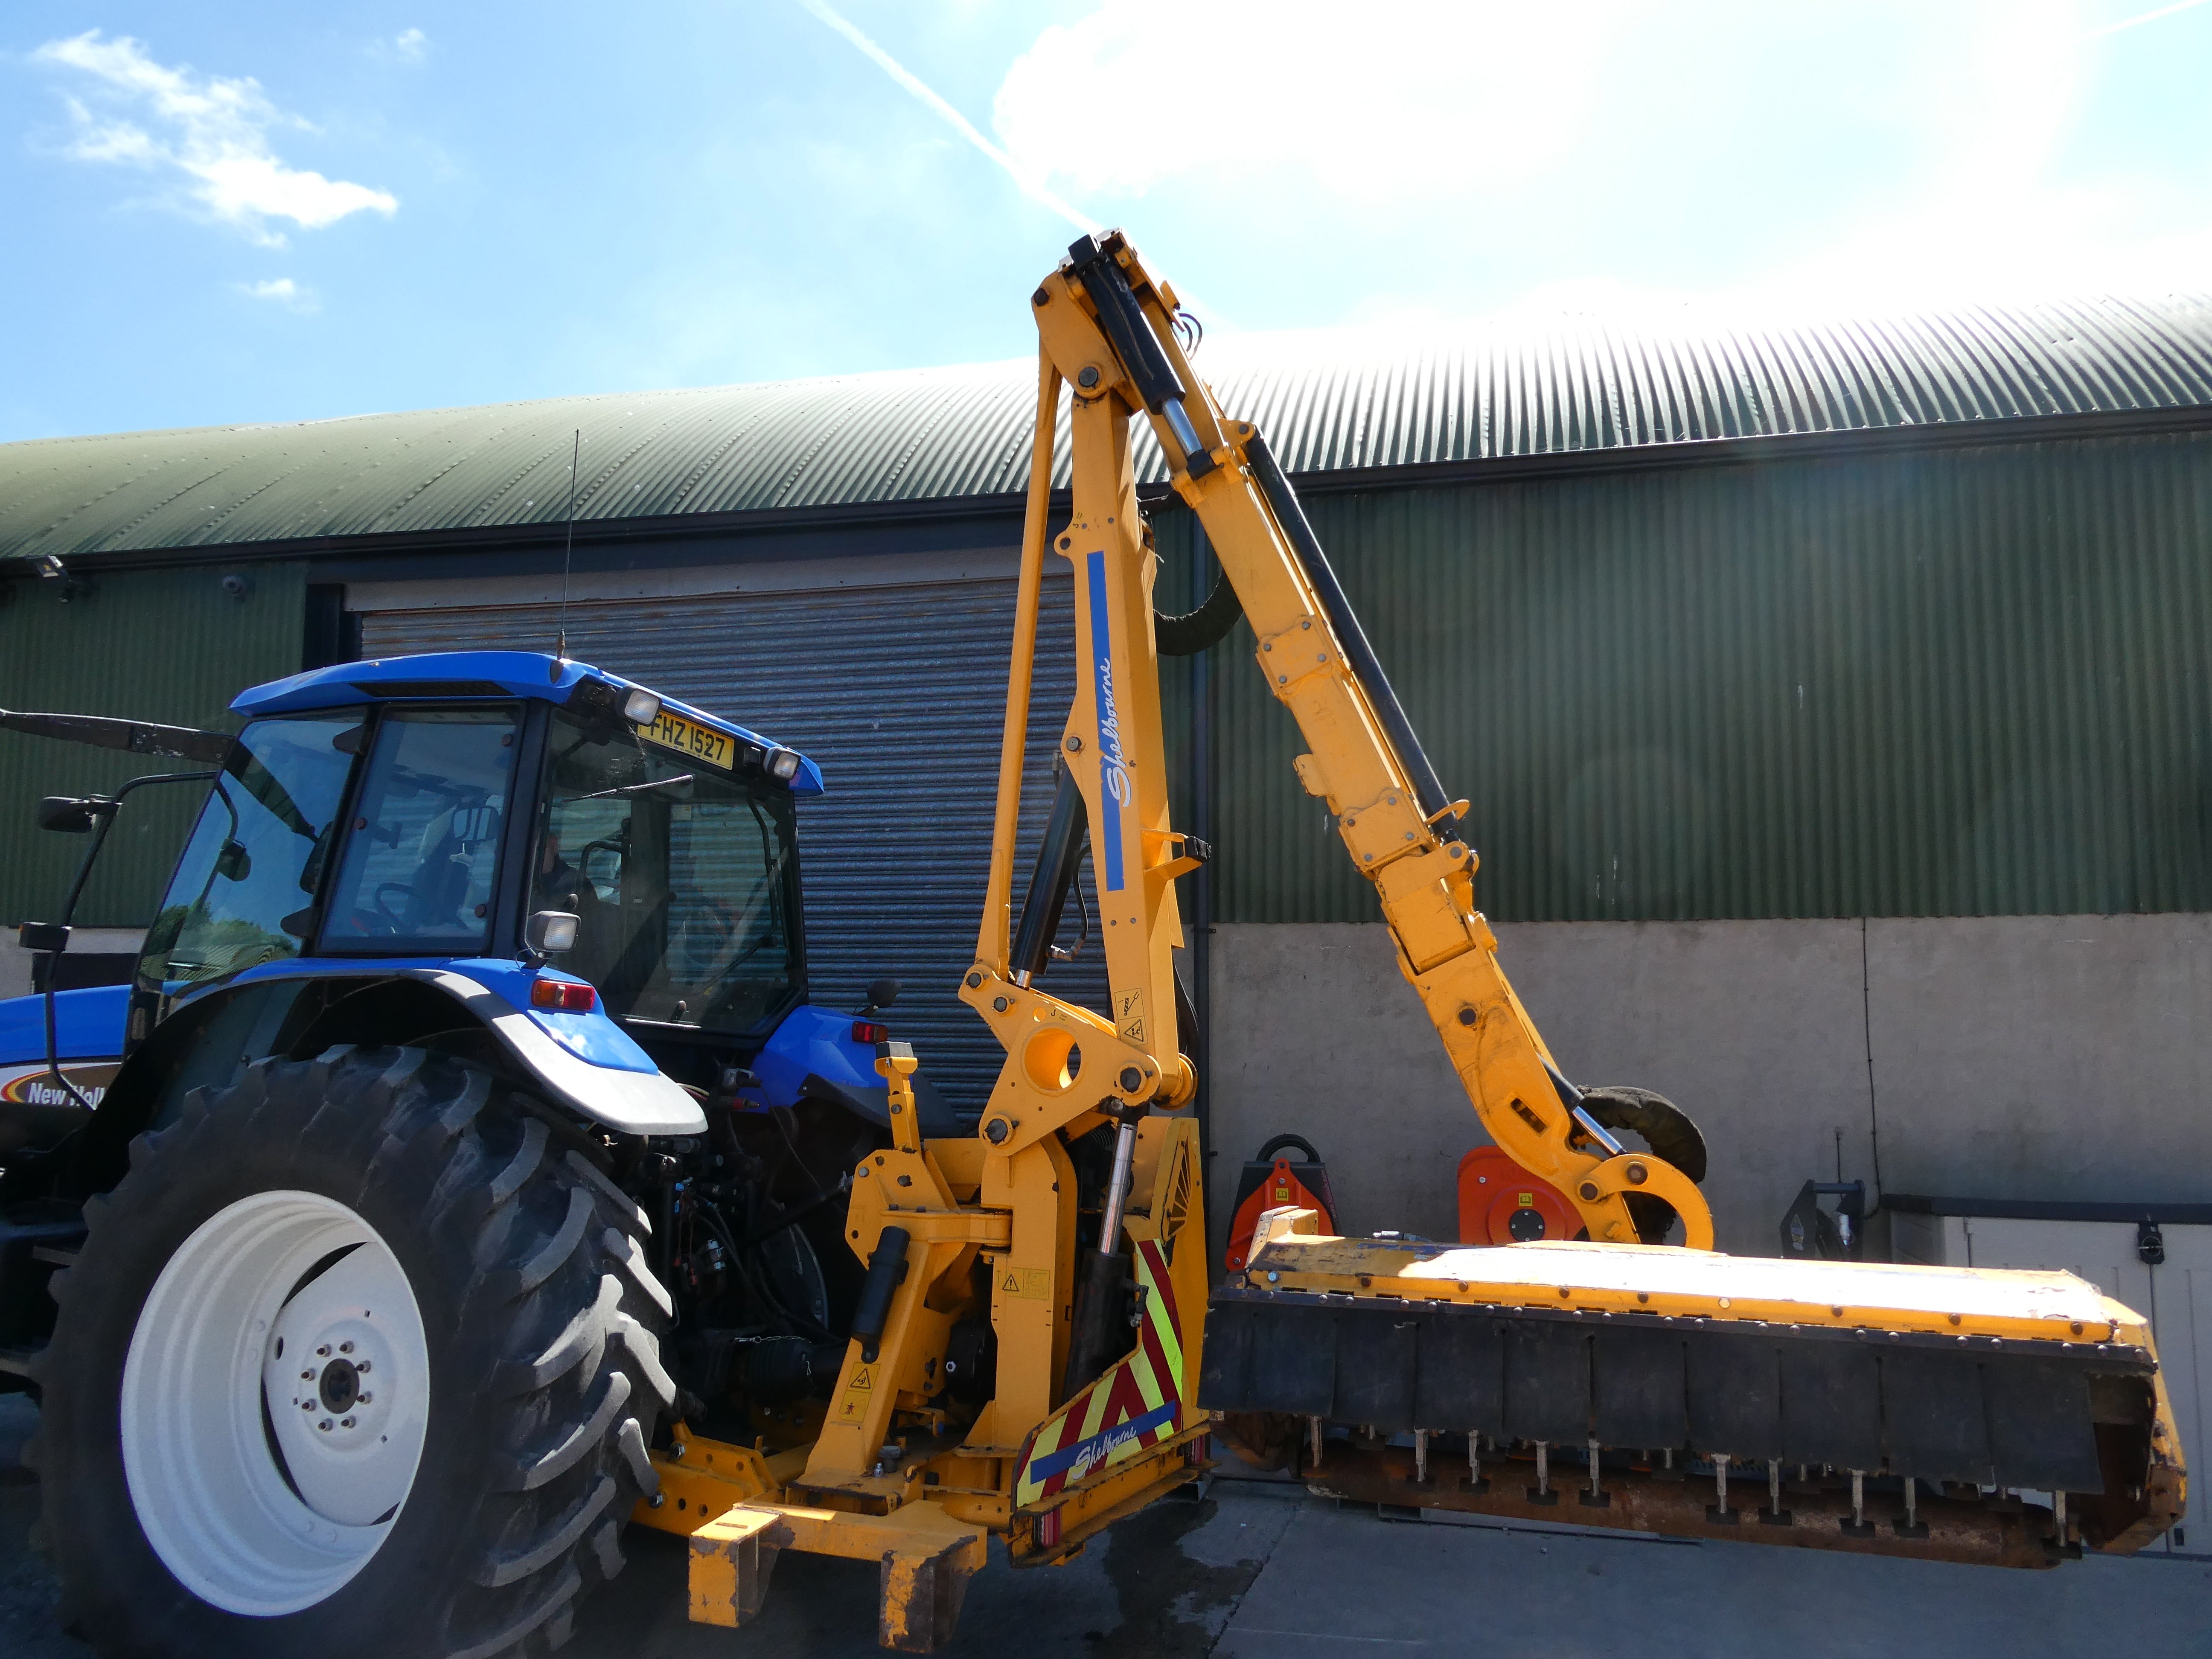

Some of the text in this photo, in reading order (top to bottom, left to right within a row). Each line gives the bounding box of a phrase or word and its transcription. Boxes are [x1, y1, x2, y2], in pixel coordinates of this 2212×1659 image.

[650, 714, 725, 761] FHZ 1527
[1100, 658, 1131, 807] Shelbourne
[28, 1083, 66, 1105] New
[1072, 1426, 1137, 1480] Shelbourne
